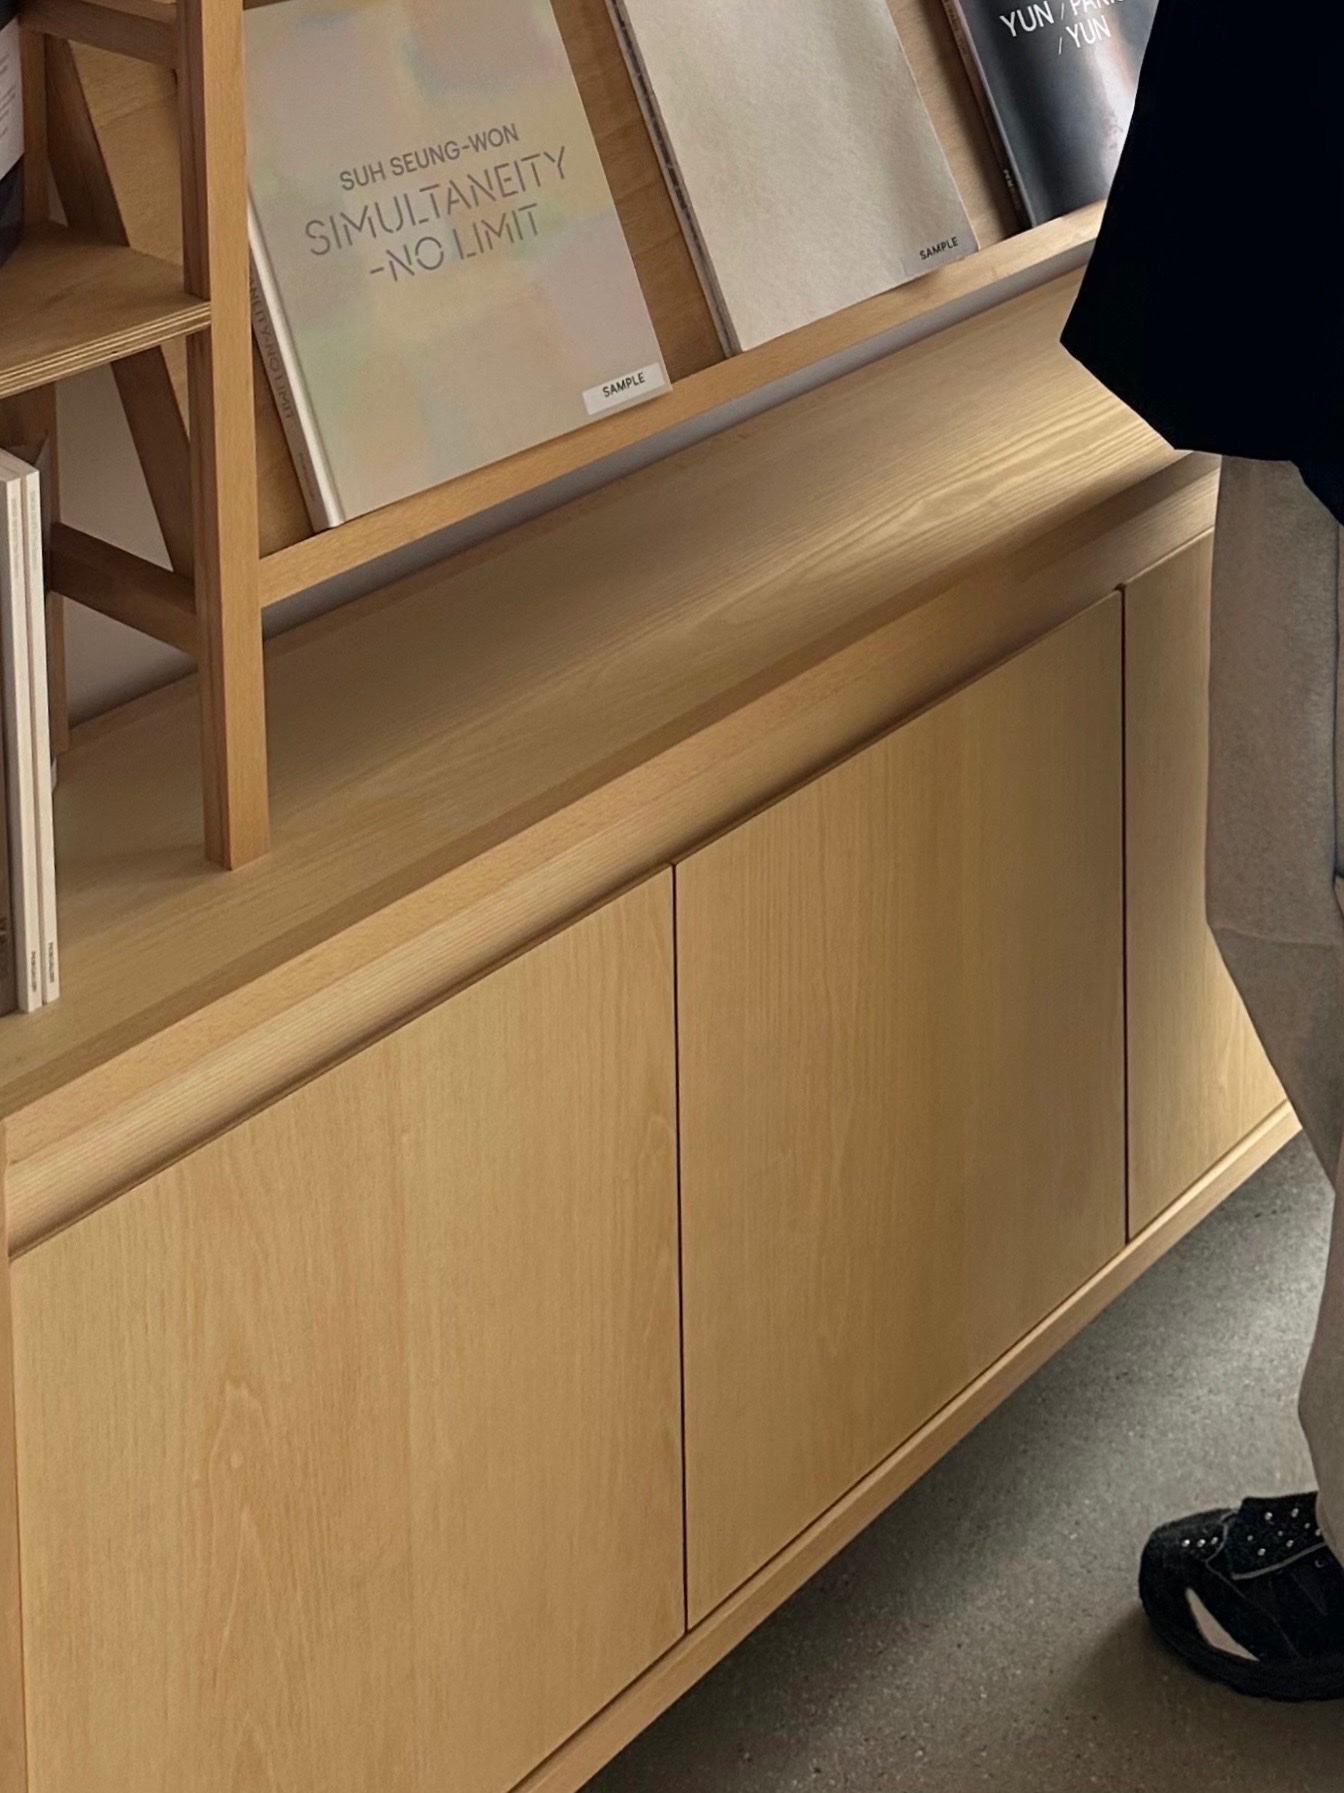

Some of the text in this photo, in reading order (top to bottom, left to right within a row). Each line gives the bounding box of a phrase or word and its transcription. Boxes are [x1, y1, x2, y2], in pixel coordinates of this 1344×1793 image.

[999, 0, 1054, 37] YUN
[1065, 15, 1111, 48] YUN
[339, 122, 519, 191] SUH SEUNG-WON
[305, 146, 565, 256] SIMULTANEITY
[369, 203, 538, 281] -NO LIMIT
[919, 236, 959, 260] SAMPLE
[602, 372, 645, 398] SAMPLE
